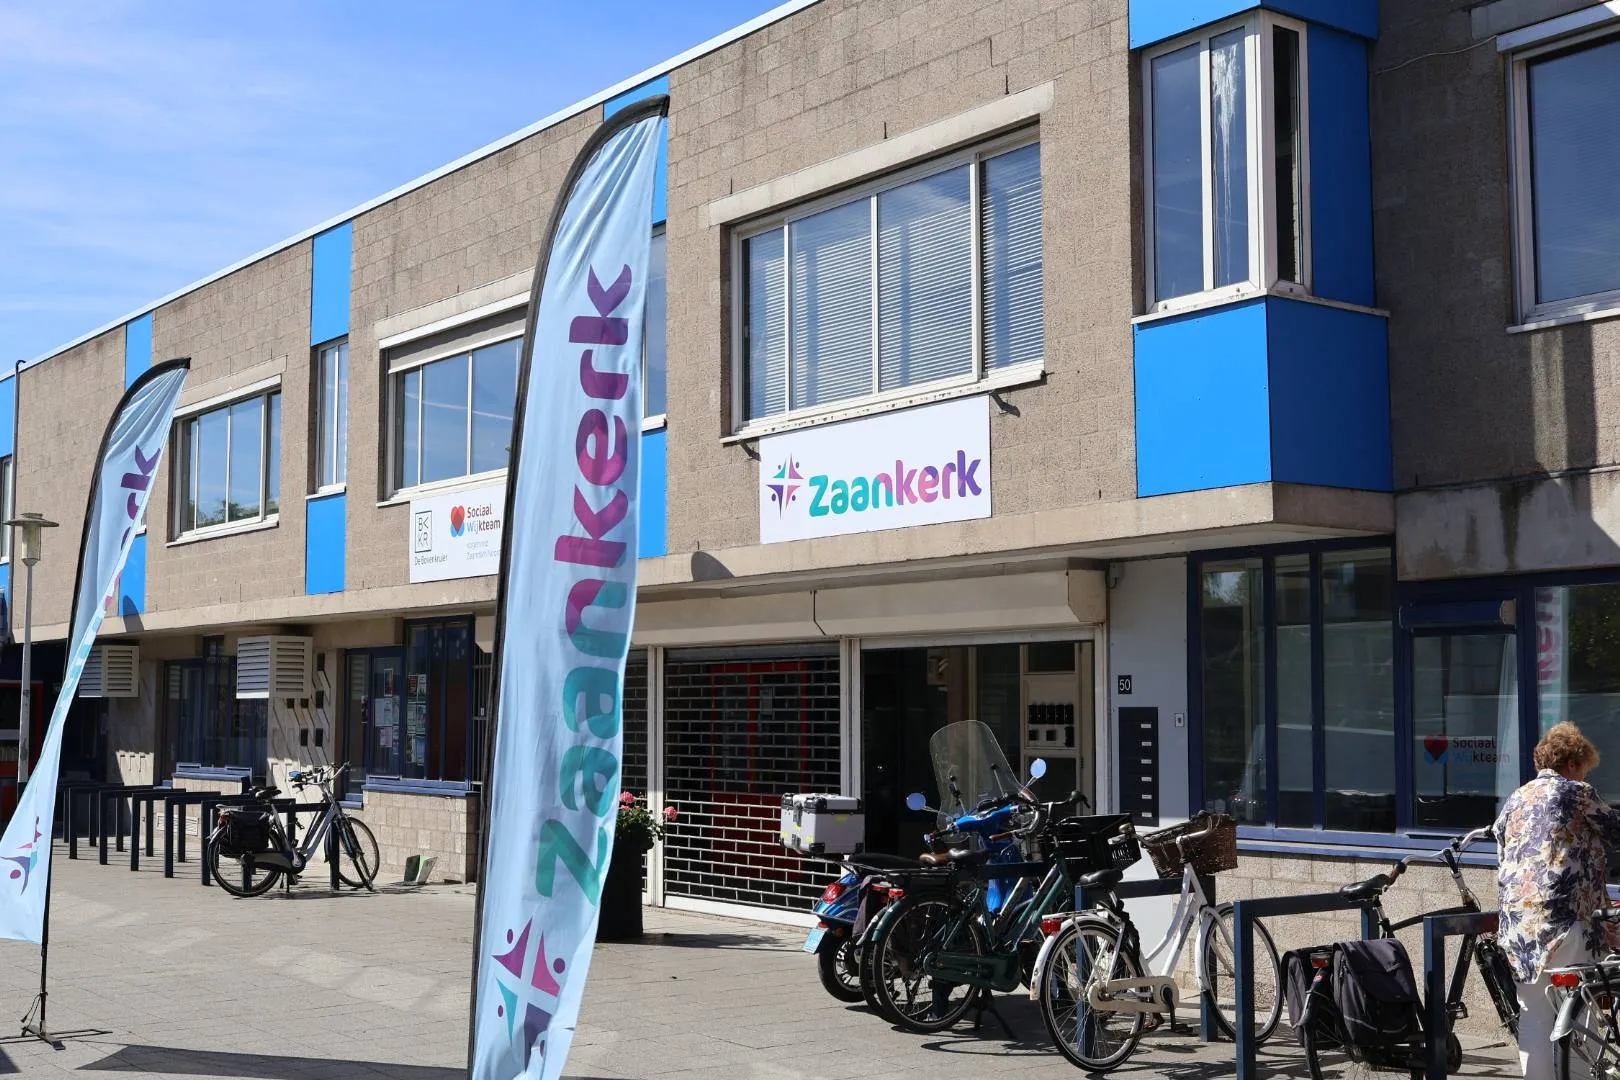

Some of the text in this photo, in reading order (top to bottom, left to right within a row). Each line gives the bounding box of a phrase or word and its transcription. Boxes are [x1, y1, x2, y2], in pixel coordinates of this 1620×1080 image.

[809, 450, 982, 517] Zaankerk
[467, 504, 492, 519] Sociaal
[467, 519, 501, 535] Wijkteam
[535, 264, 632, 906] Zaankerk
[1119, 679, 1131, 691] 50
[1453, 736, 1497, 748] Sociaal
